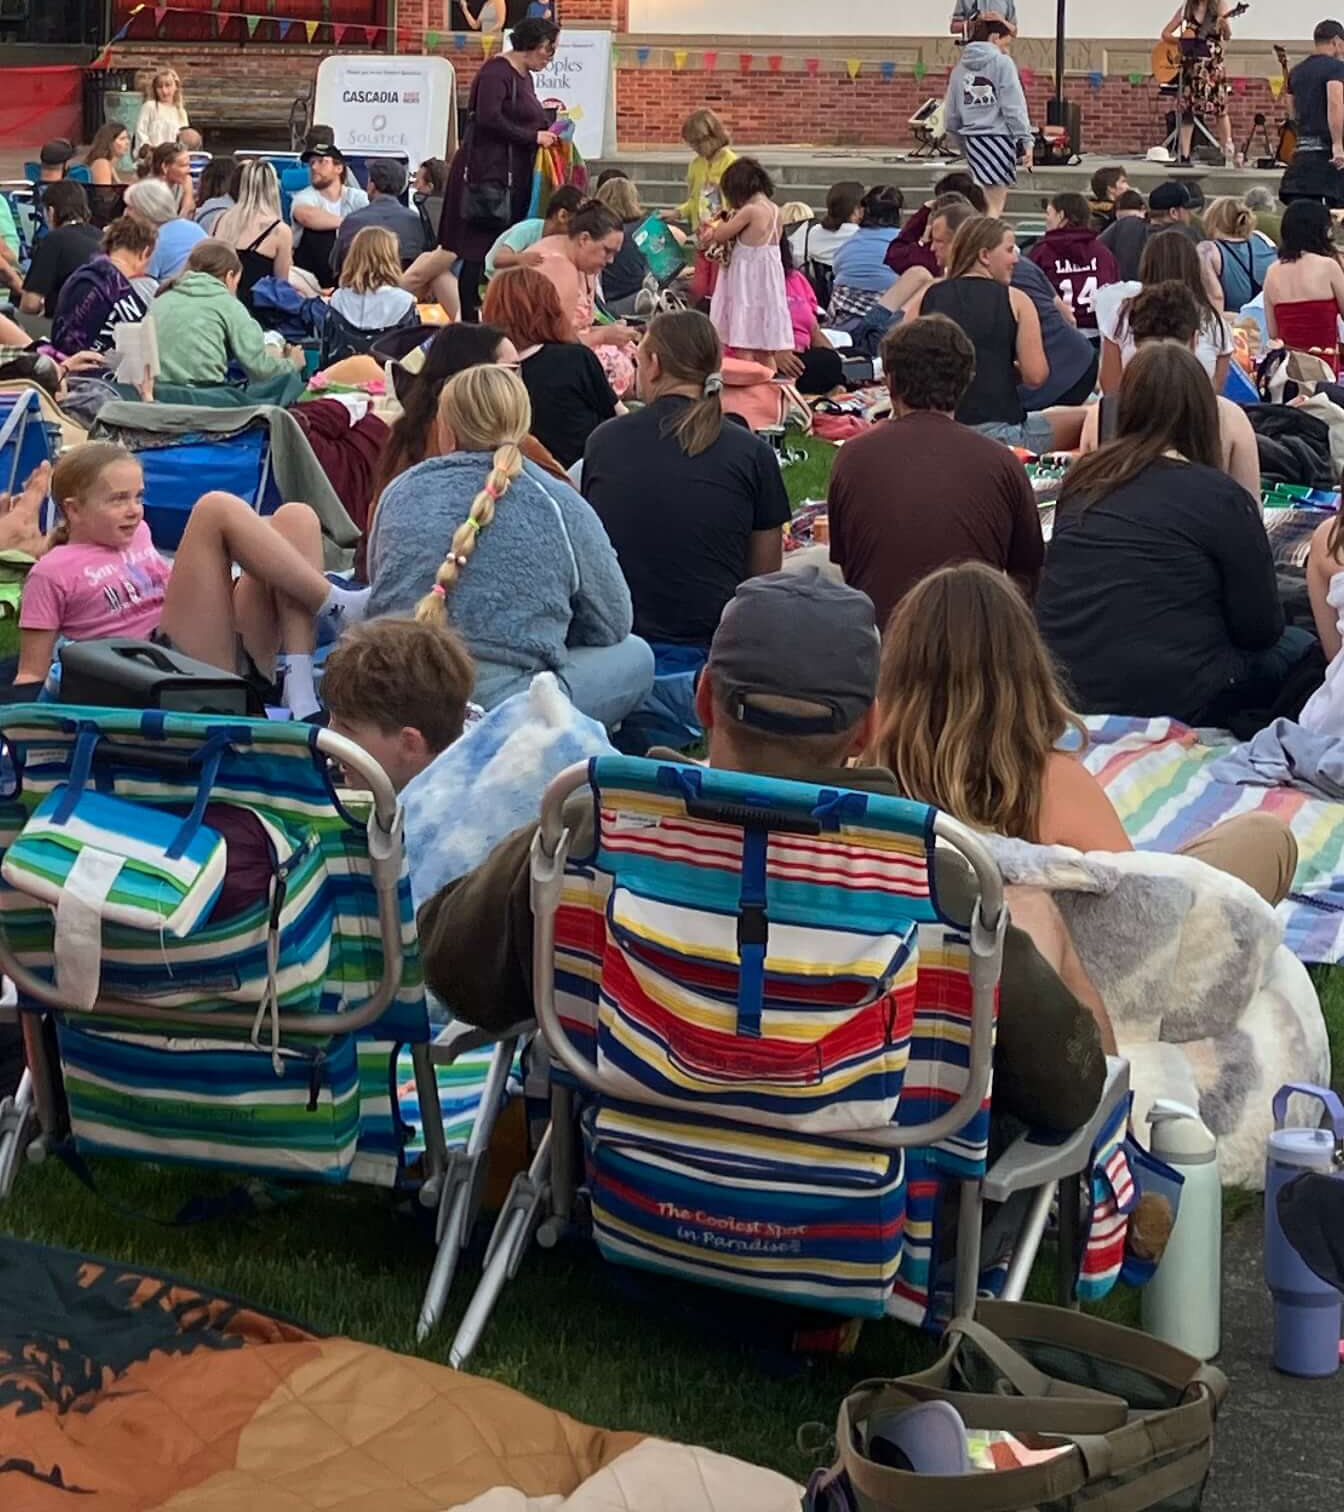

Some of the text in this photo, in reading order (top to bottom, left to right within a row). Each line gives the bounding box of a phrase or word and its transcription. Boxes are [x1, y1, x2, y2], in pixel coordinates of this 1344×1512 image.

[545, 56, 583, 77] oples
[536, 73, 571, 89] Bank
[342, 90, 399, 104] CASCADIA
[1059, 276, 1098, 313] 14
[656, 1201, 807, 1239] The Coolest Spot
